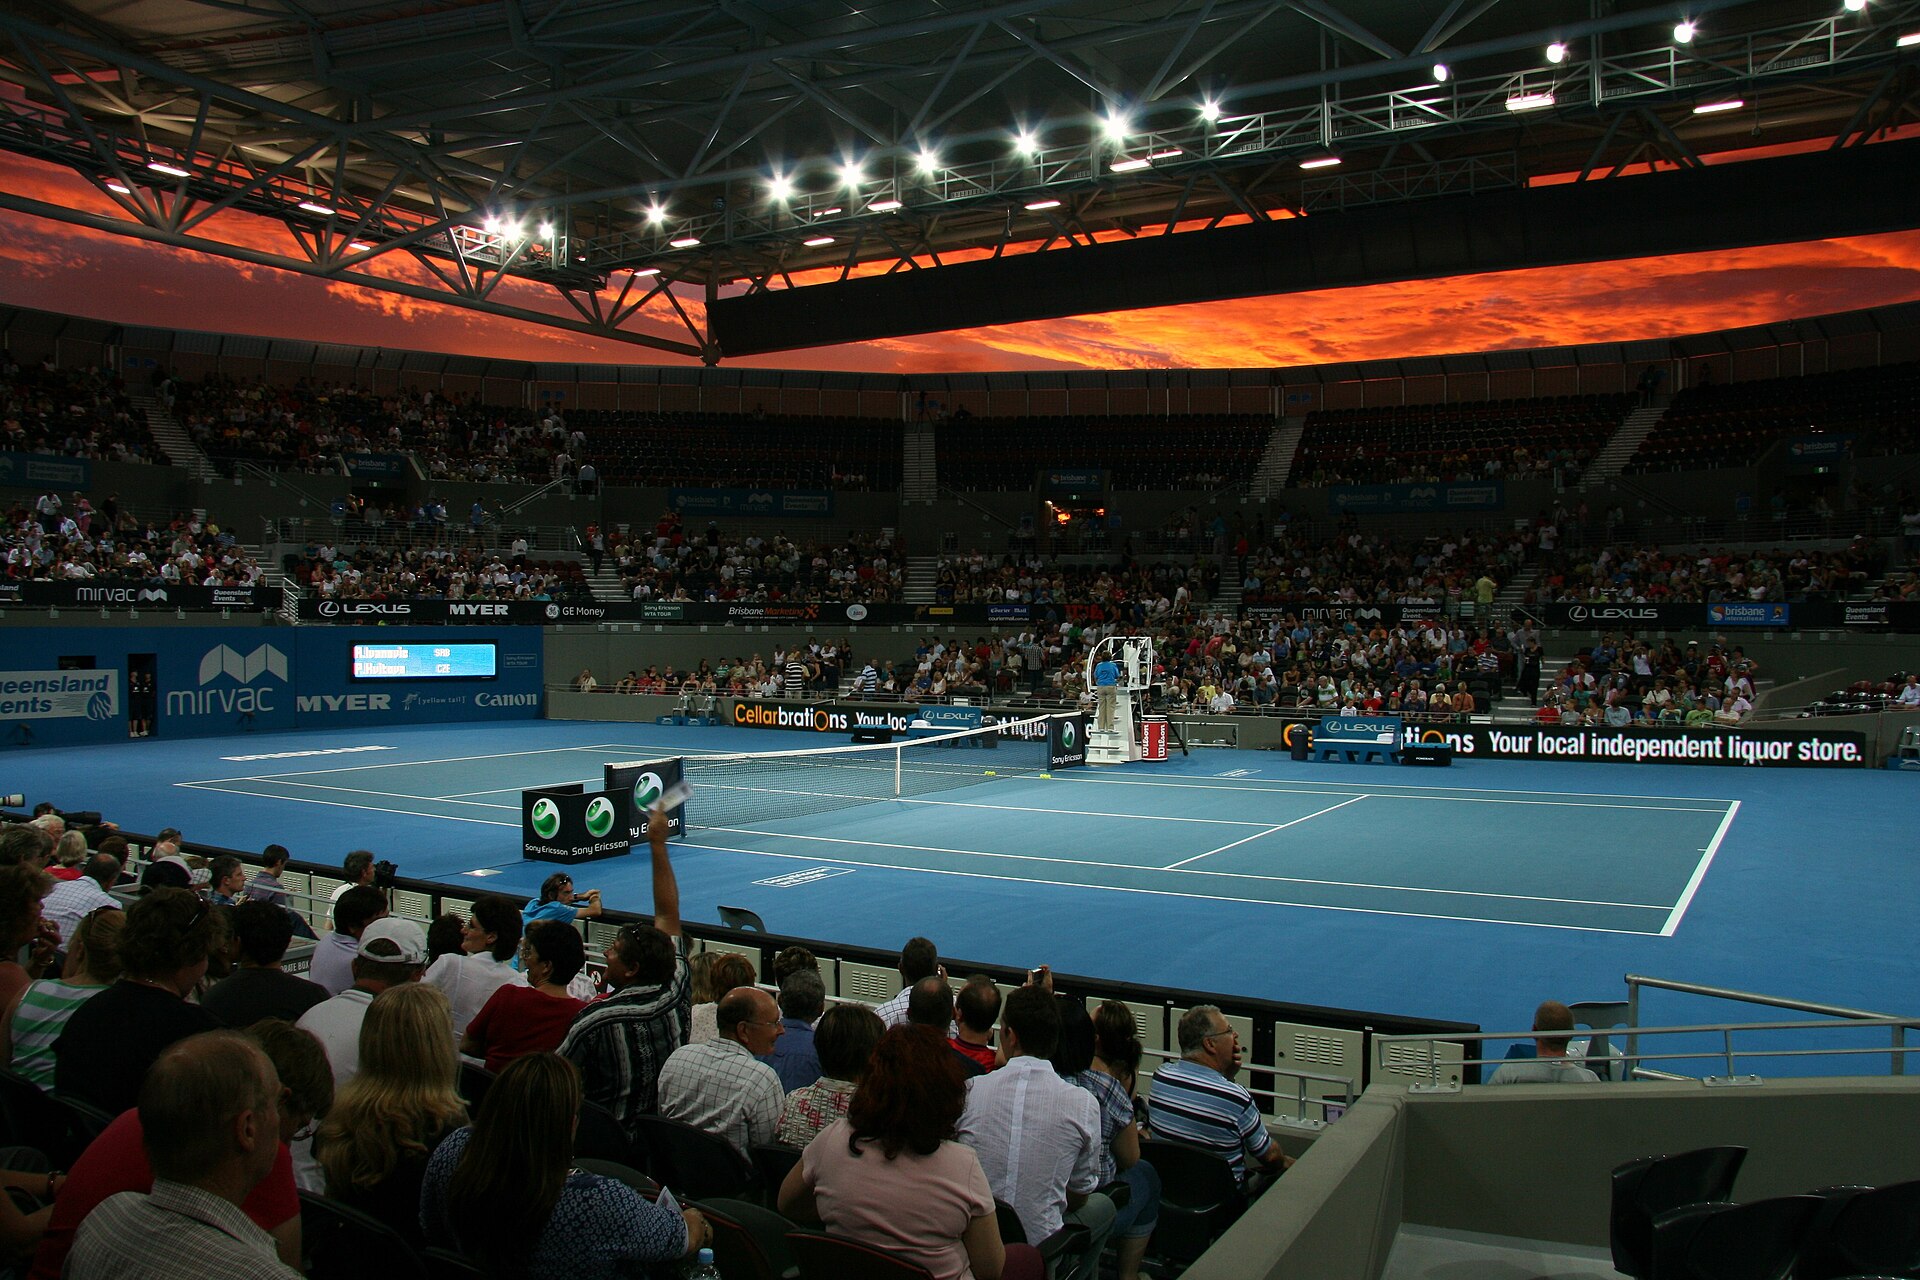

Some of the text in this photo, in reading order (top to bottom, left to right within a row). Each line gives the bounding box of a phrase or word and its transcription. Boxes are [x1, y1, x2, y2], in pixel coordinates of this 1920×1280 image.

[78, 588, 136, 602] mirvac
[343, 604, 411, 614] LEXUS
[449, 604, 509, 615] MYER
[562, 606, 605, 618] GE Money
[728, 606, 804, 618] Brisbane Marketing
[1592, 608, 1659, 618] LEXUS
[1725, 605, 1766, 616] brisbane
[167, 687, 274, 717] mirvac
[297, 693, 391, 712] MYER
[474, 691, 538, 708] Canon
[735, 703, 848, 732] Cellarbrations
[888, 712, 907, 731] loc
[1344, 722, 1395, 732] LEXUS
[1158, 724, 1166, 758] Wilson
[1488, 730, 1534, 754] Your
[1537, 731, 1585, 755] local
[1591, 732, 1723, 762] independent
[1728, 734, 1792, 765] liquor
[1797, 737, 1863, 762] store.
[1052, 753, 1083, 764] Sony Ericsson
[525, 843, 569, 857] Sony Ericsson
[571, 840, 629, 857] Sony Ericsson
